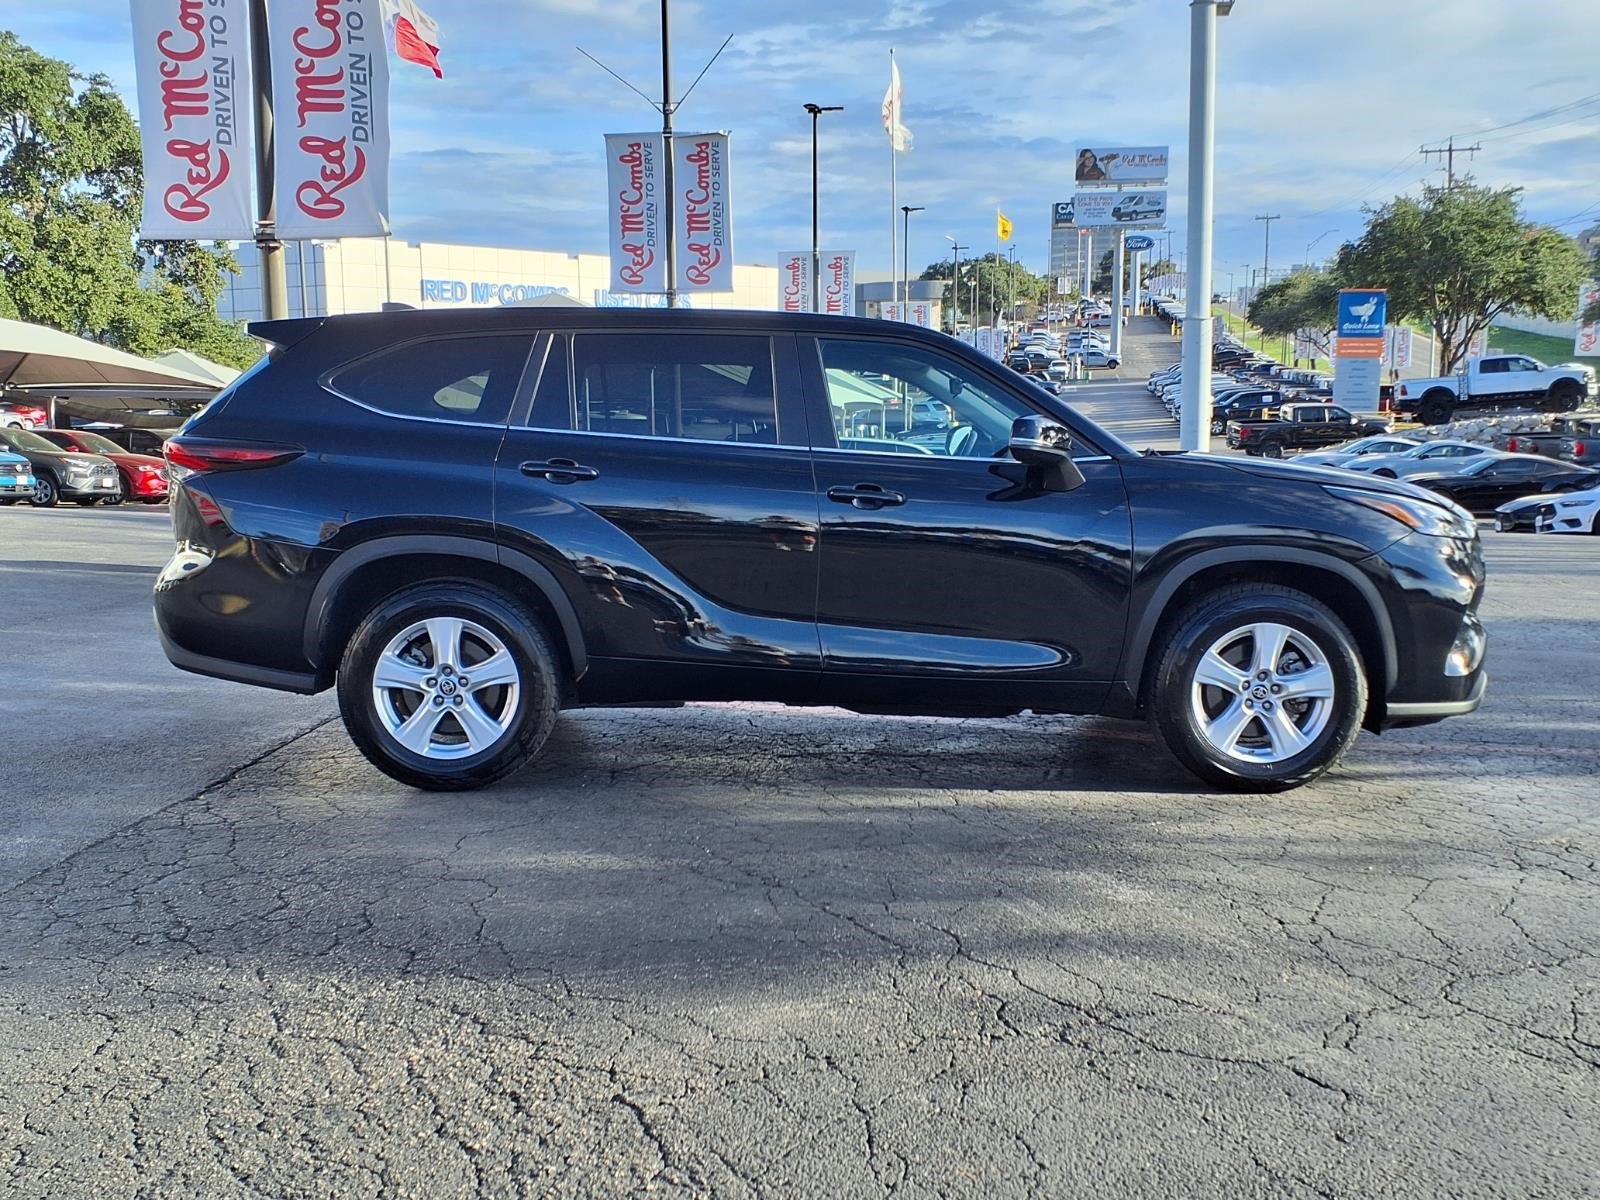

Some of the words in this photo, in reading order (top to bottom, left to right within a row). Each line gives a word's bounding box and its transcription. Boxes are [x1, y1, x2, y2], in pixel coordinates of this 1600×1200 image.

[210, 15, 228, 48] TO
[346, 11, 365, 45] TO
[157, 0, 211, 132] McCom
[293, 0, 347, 129] McCo
[213, 56, 232, 146] DRIVEN
[351, 53, 370, 144] DRIVEN
[164, 138, 231, 222] Red
[296, 136, 367, 220] Red
[645, 142, 654, 180] SERVE
[711, 140, 721, 179] SERVE
[619, 141, 645, 240] McCombs
[646, 182, 655, 199] TO
[686, 141, 711, 239] McCombs
[712, 182, 721, 199] TO
[647, 203, 657, 247] DRIVEN
[713, 203, 722, 247] DRIVEN
[1126, 239, 1148, 249] Ford
[619, 243, 655, 286] Red
[686, 243, 721, 286] Red
[784, 257, 801, 312] McCombs
[826, 256, 843, 314] McCombs
[421, 279, 467, 303] RED
[594, 289, 641, 308] USED
